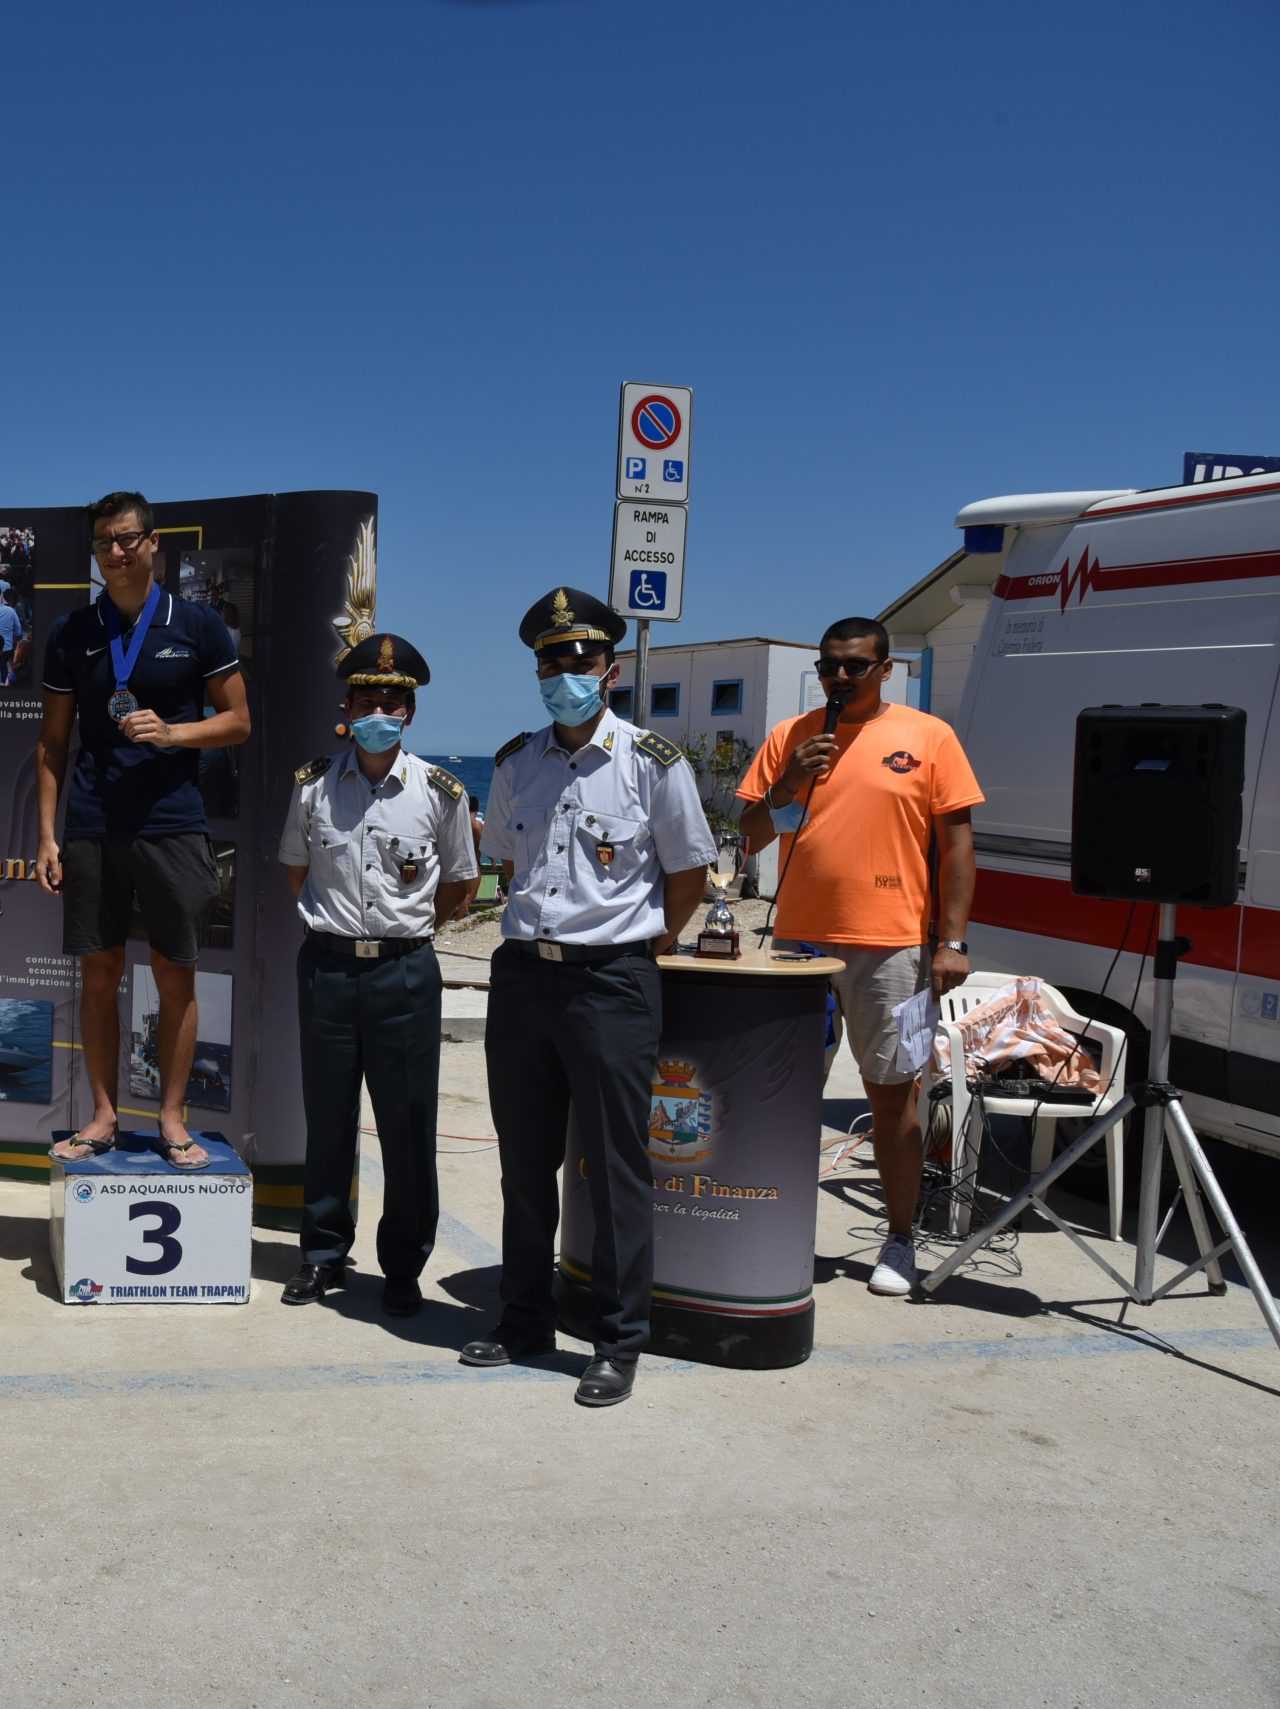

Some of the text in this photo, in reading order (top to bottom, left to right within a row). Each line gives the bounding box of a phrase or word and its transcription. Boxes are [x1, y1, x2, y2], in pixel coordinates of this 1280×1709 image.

[628, 458, 643, 478] P
[634, 510, 669, 525] RAMPA
[646, 531, 656, 544] DI
[624, 549, 675, 565] ACCESSO
[1028, 574, 1061, 587] ORION
[26, 956, 72, 966] contrasto
[100, 1184, 126, 1194] ASD
[129, 1184, 195, 1195] AQUARIUS
[199, 1184, 246, 1194] NUOTO
[664, 1173, 780, 1200] di Finanza
[673, 1203, 687, 1215] la
[691, 1206, 740, 1221] legalità
[126, 1200, 183, 1276] 3
[110, 1285, 166, 1298] TRIATHLON
[169, 1285, 198, 1297] TEAM
[201, 1285, 245, 1298] TRAPANI
